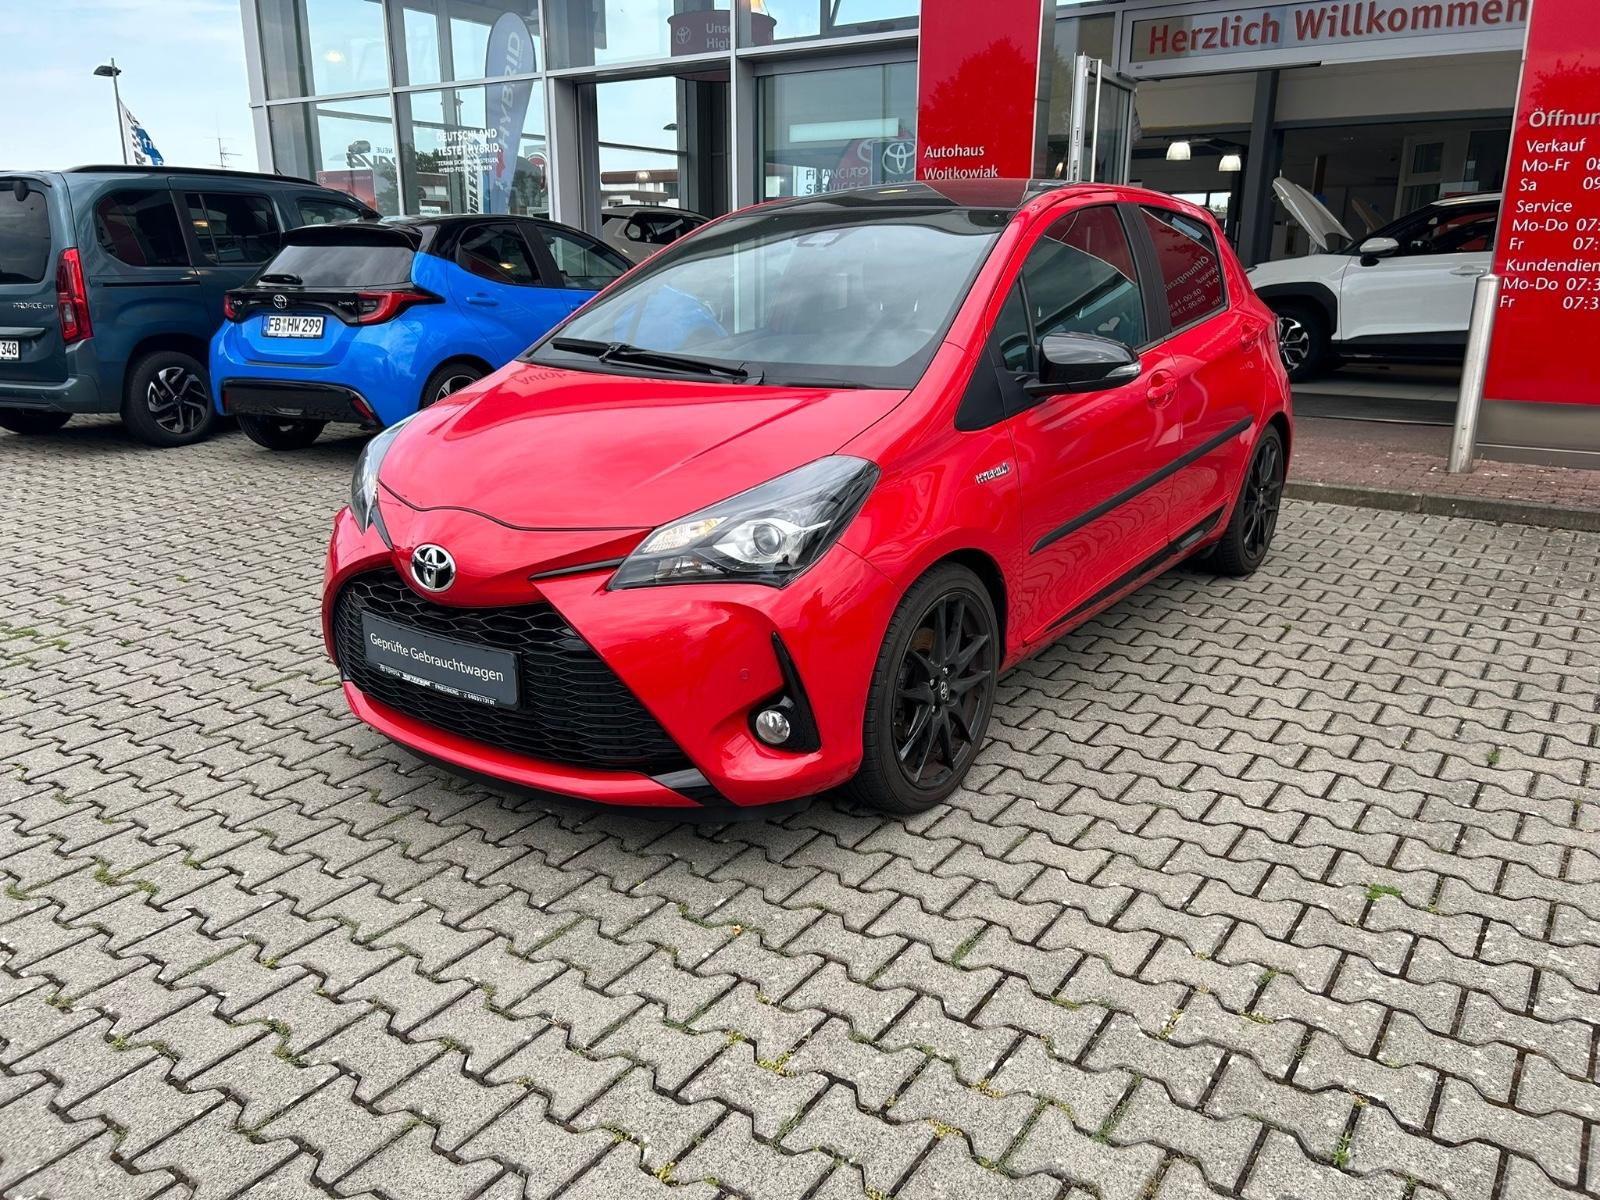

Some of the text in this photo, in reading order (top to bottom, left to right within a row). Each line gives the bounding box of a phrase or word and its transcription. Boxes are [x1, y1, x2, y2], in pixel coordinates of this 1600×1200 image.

[1149, 0, 1526, 55] Herzlich Willkommen
[924, 143, 985, 159] Autohaus
[1526, 137, 1587, 153] Verkauf
[923, 164, 998, 179] Woitkowiak
[1521, 158, 1570, 172] Mo-Fr
[1519, 178, 1537, 191] Sa
[1515, 199, 1573, 213] Service
[1511, 218, 1568, 232] Mo-Do
[1509, 237, 1524, 250] Fr
[1505, 258, 1600, 272] Kundendien
[1503, 277, 1559, 290] Mo-Do
[1499, 295, 1599, 310] Fr 07:3
[268, 317, 322, 333] FB HW 299
[1, 342, 17, 355] 348
[370, 632, 409, 657] Geprüfte
[410, 647, 504, 682] Gebrauchtwagen
